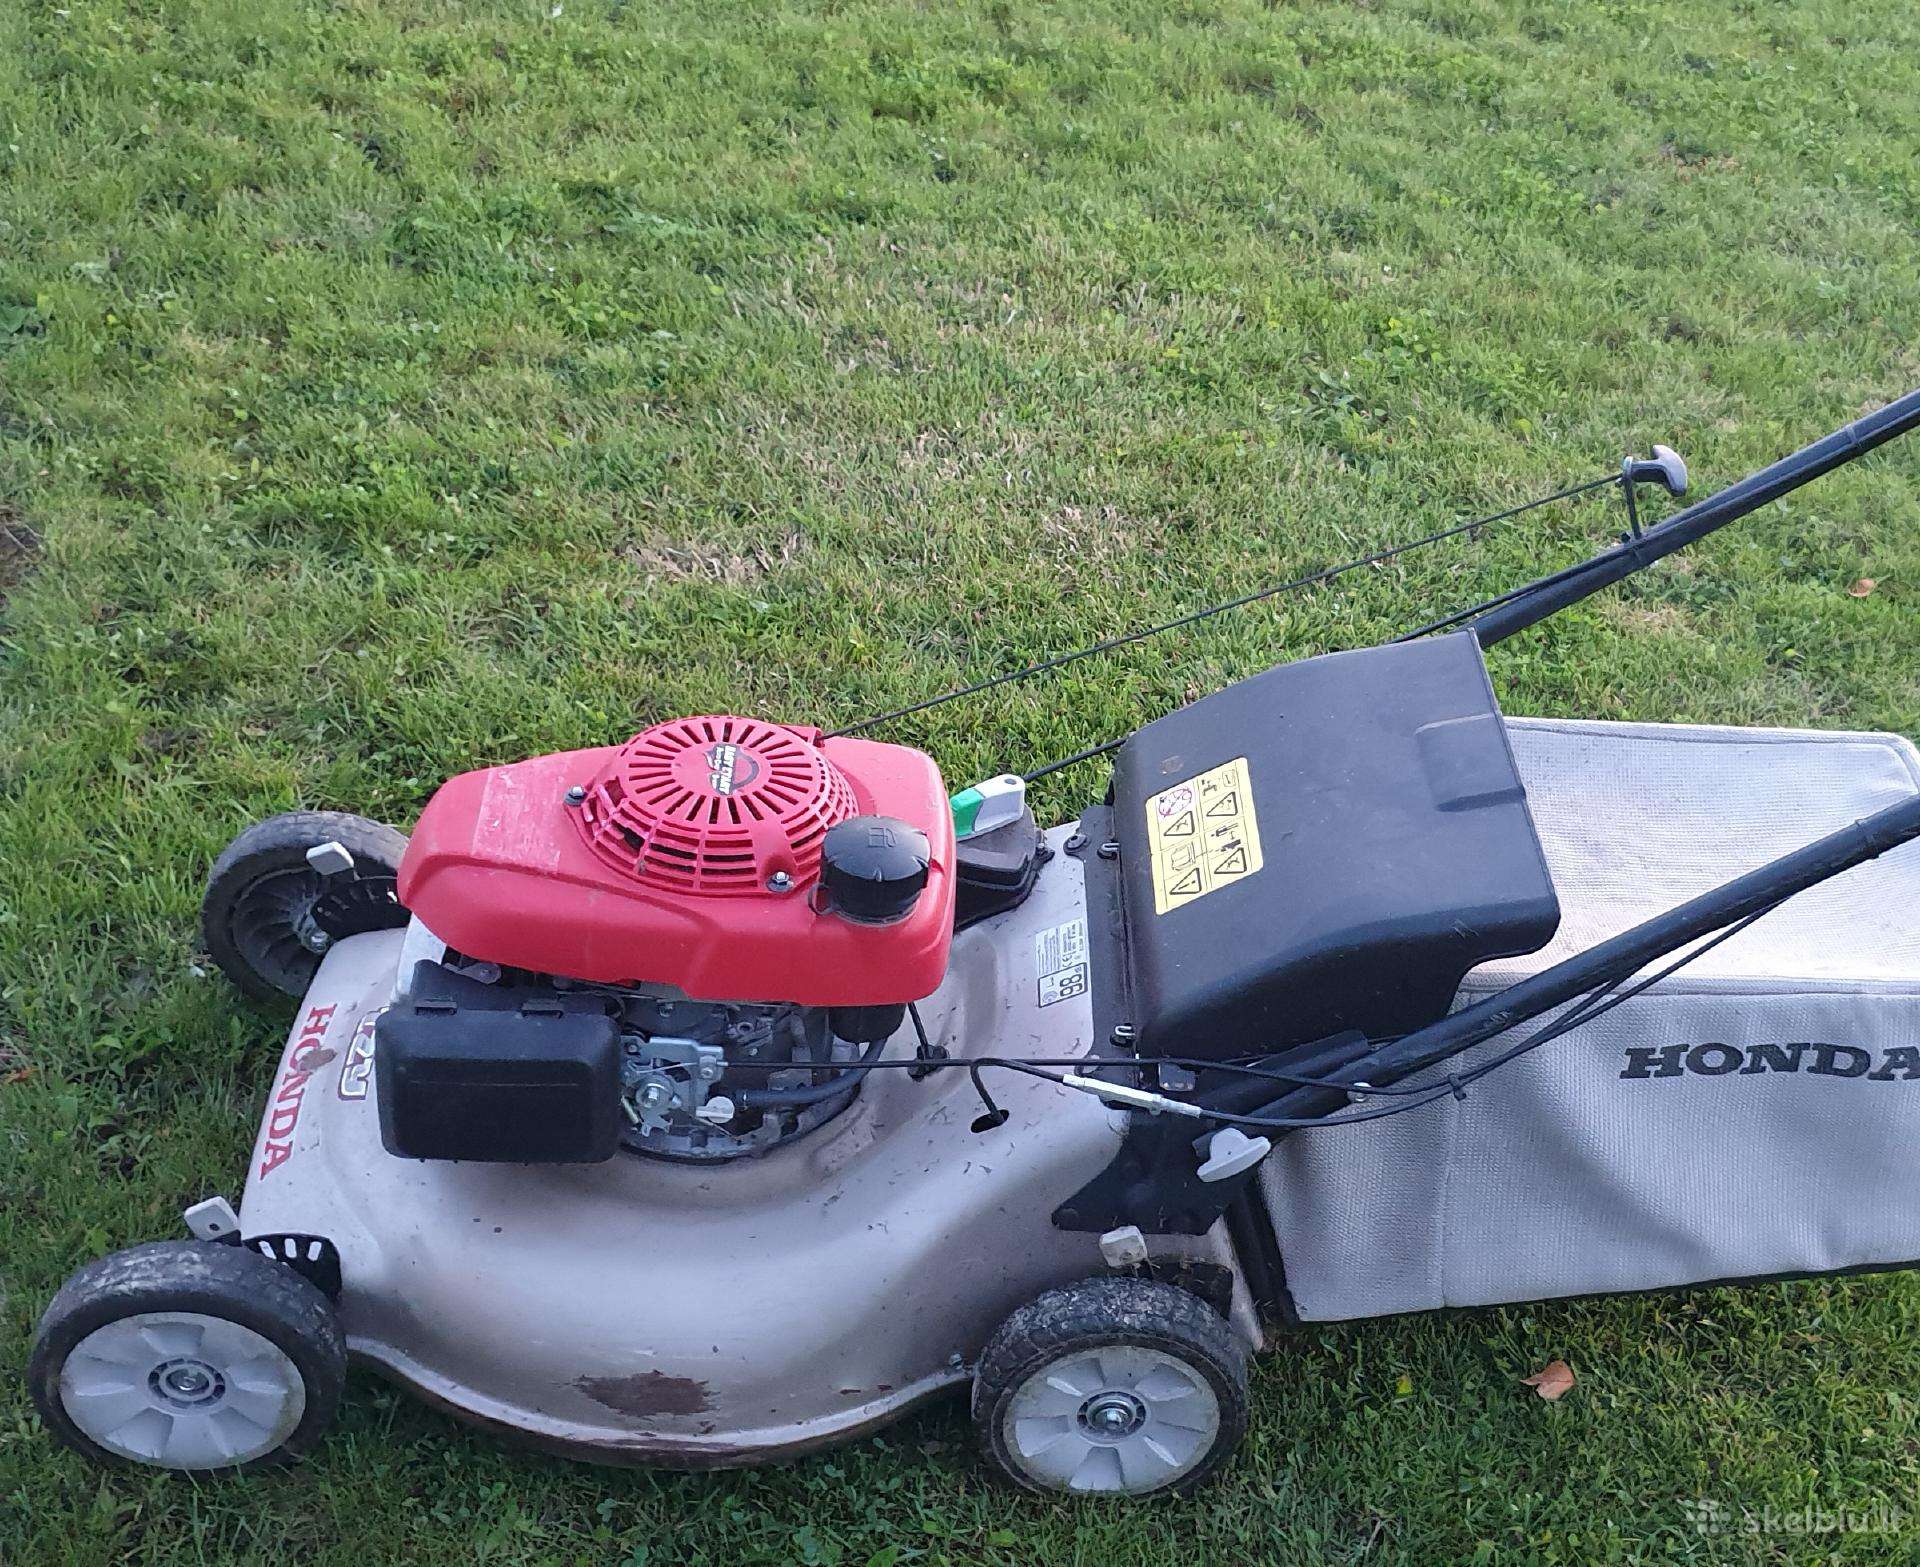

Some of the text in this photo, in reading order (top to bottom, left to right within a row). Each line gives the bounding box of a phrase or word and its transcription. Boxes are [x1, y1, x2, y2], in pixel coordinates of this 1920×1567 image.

[1060, 973, 1083, 997] 98
[1619, 1042, 1920, 1081] HONDA
[260, 1003, 338, 1181] HONDA
